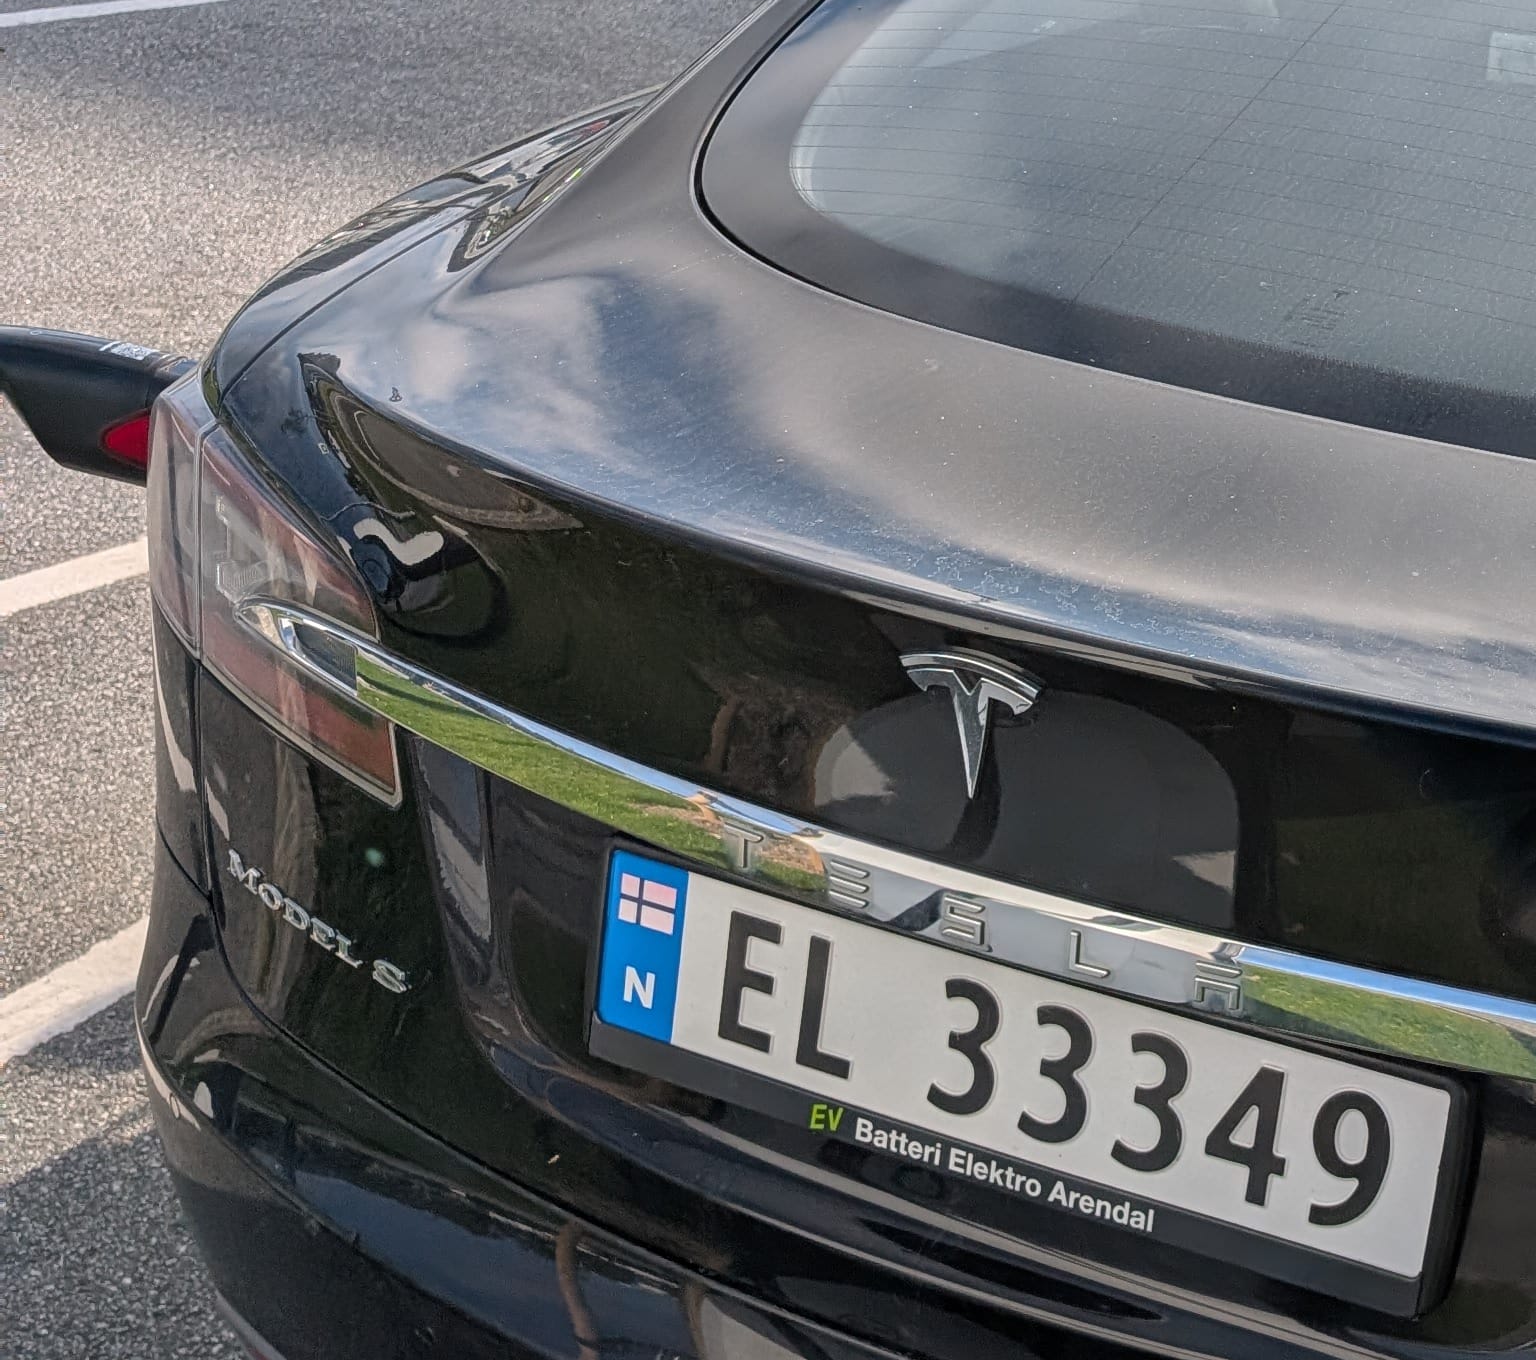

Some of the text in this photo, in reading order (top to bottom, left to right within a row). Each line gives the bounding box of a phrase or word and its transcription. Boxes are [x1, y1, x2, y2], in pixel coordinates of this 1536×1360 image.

[372, 959, 408, 994] S
[723, 823, 1243, 1012] TESLA
[623, 965, 656, 1009] N
[718, 910, 1392, 1227] EL 33349
[809, 1103, 1155, 1233] EV Batteri Elektro Arendal
